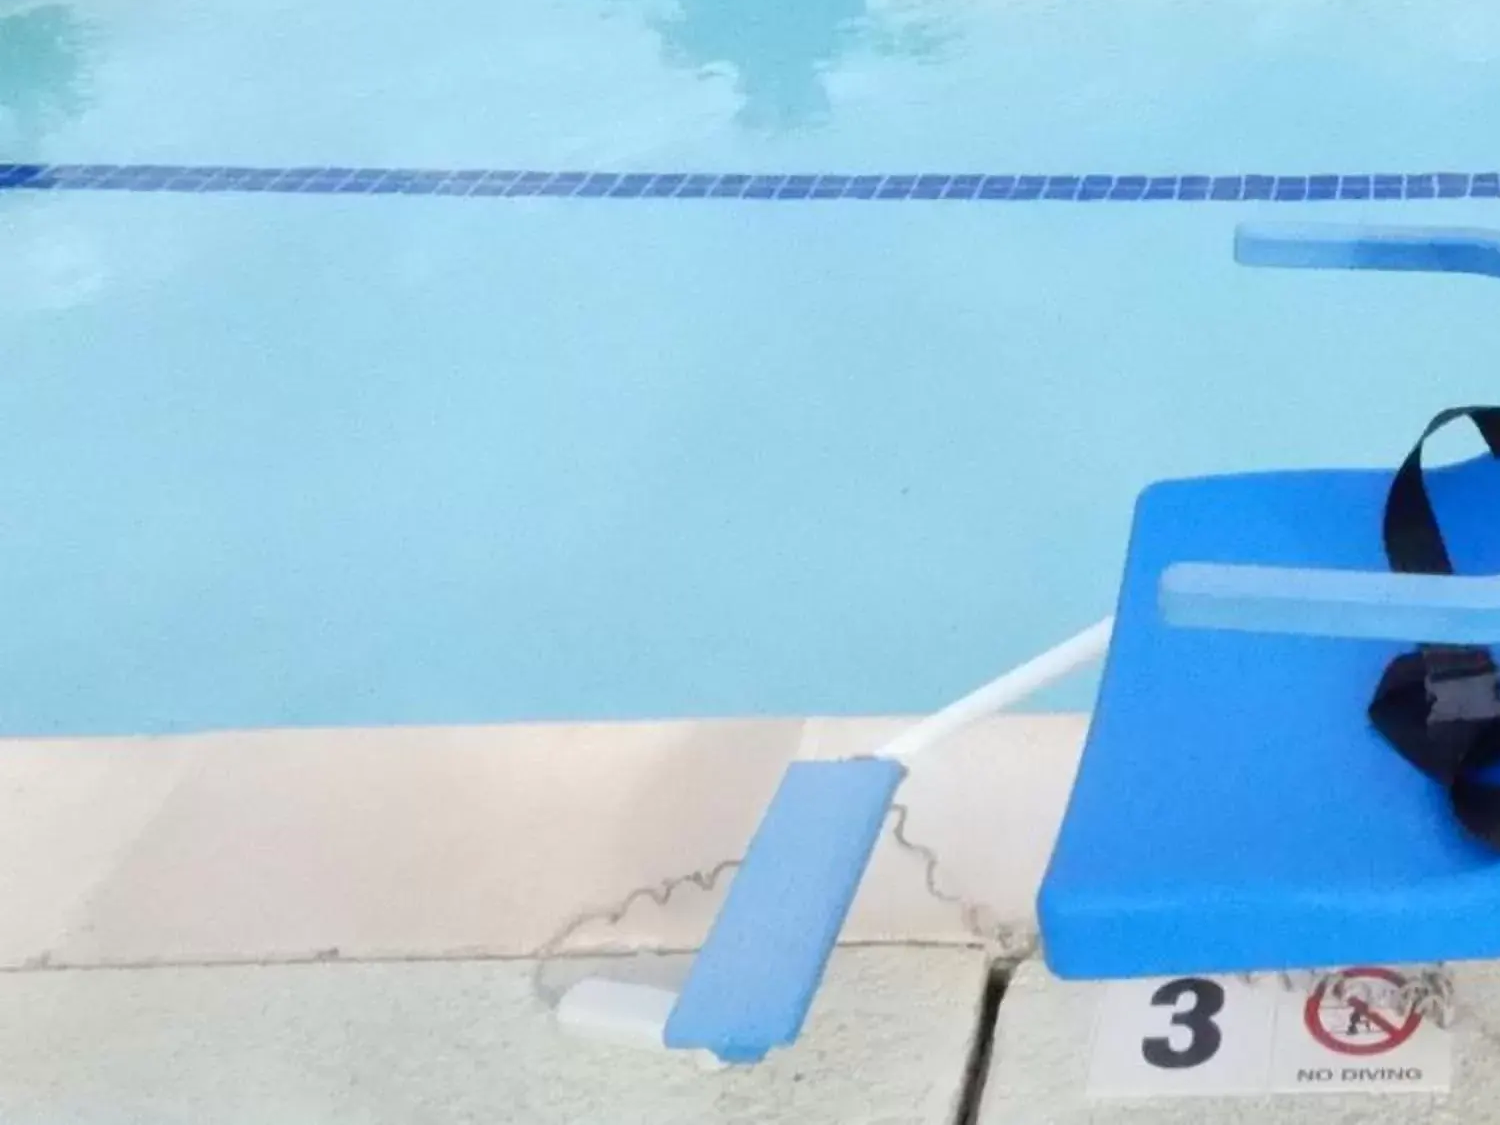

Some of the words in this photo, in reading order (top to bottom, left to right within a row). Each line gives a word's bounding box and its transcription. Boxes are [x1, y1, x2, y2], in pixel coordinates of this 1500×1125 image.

[1142, 977, 1225, 1069] 3
[1297, 1067, 1333, 1082] NO
[1341, 1066, 1423, 1081] DIVING
